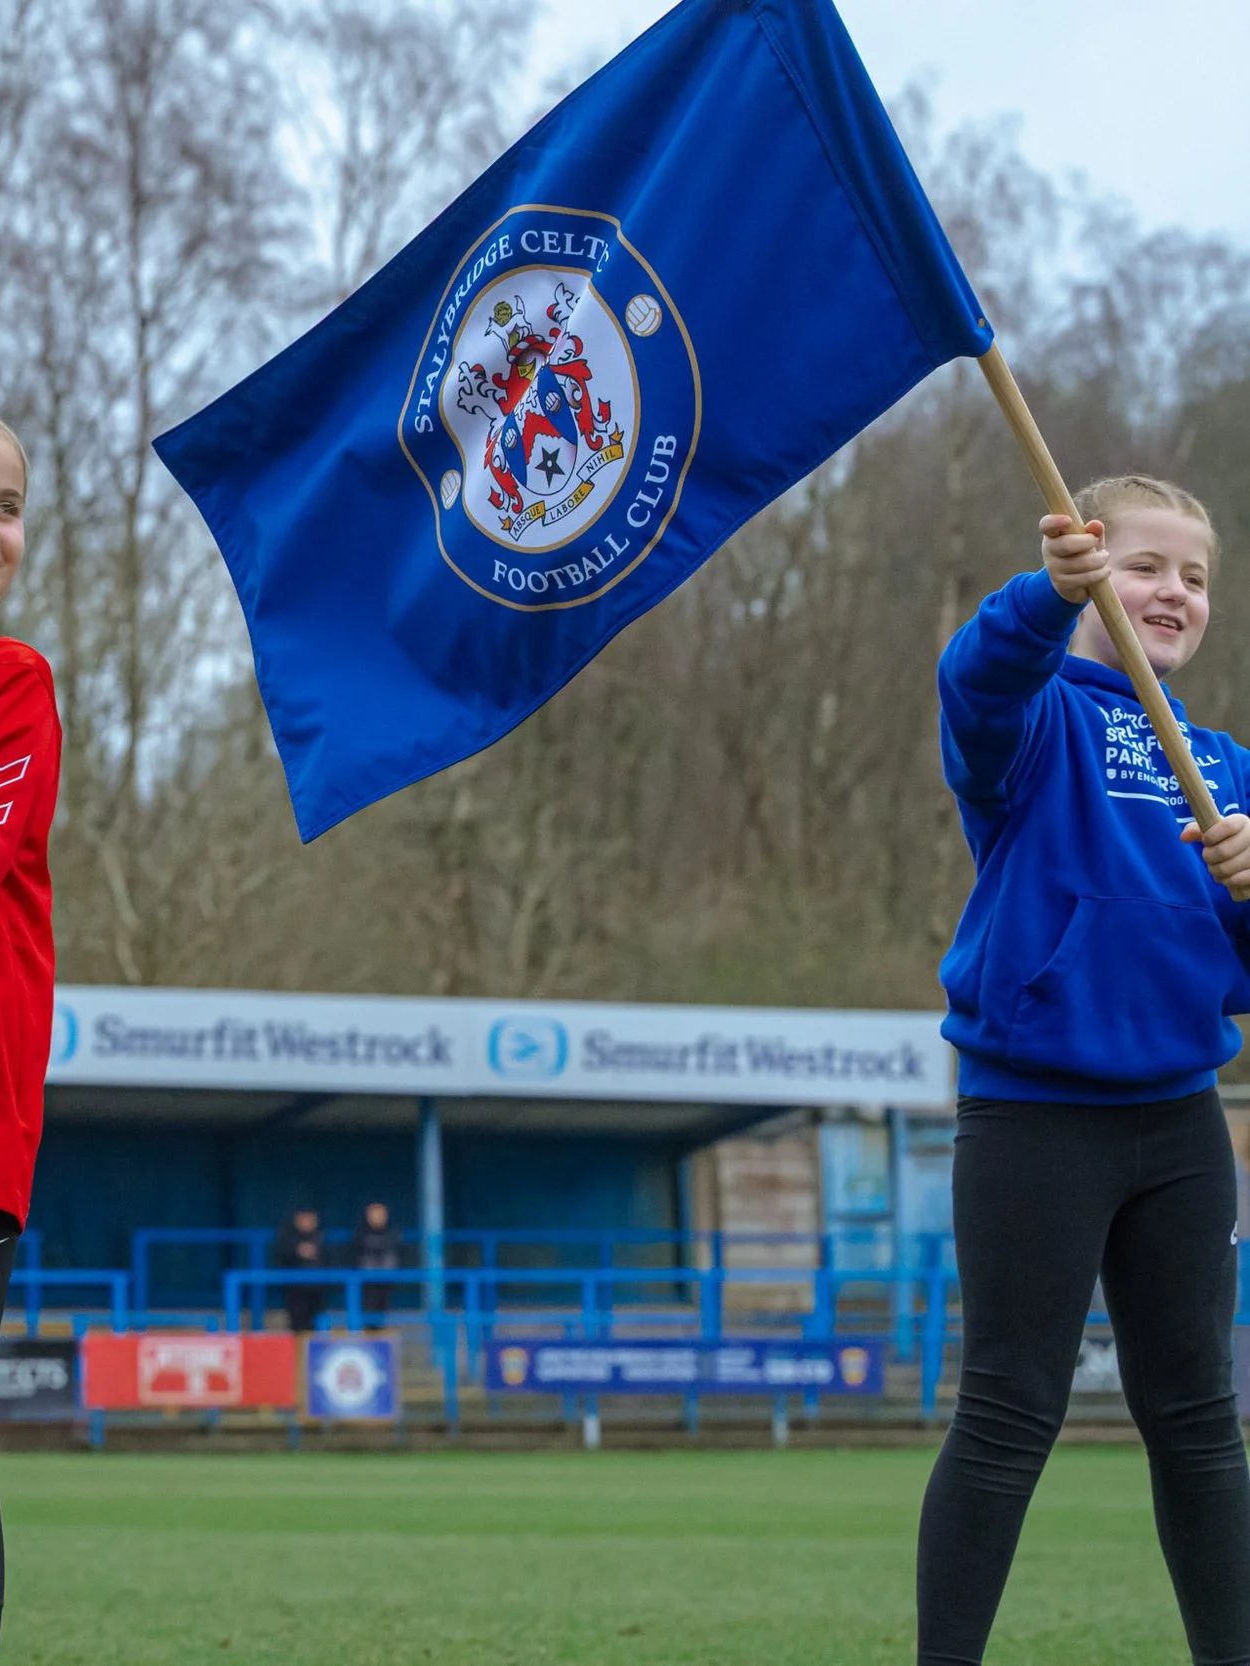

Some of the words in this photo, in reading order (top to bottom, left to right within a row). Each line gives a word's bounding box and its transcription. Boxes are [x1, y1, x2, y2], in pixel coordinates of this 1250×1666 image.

[415, 234, 513, 434] STALYBRIDGE
[493, 533, 631, 594] FOOTBALL
[626, 434, 677, 529] CLUB
[512, 505, 541, 536] ABSQUE
[550, 488, 585, 521] LABORE
[585, 449, 616, 474] NIHIL
[1120, 769, 1135, 780] BY
